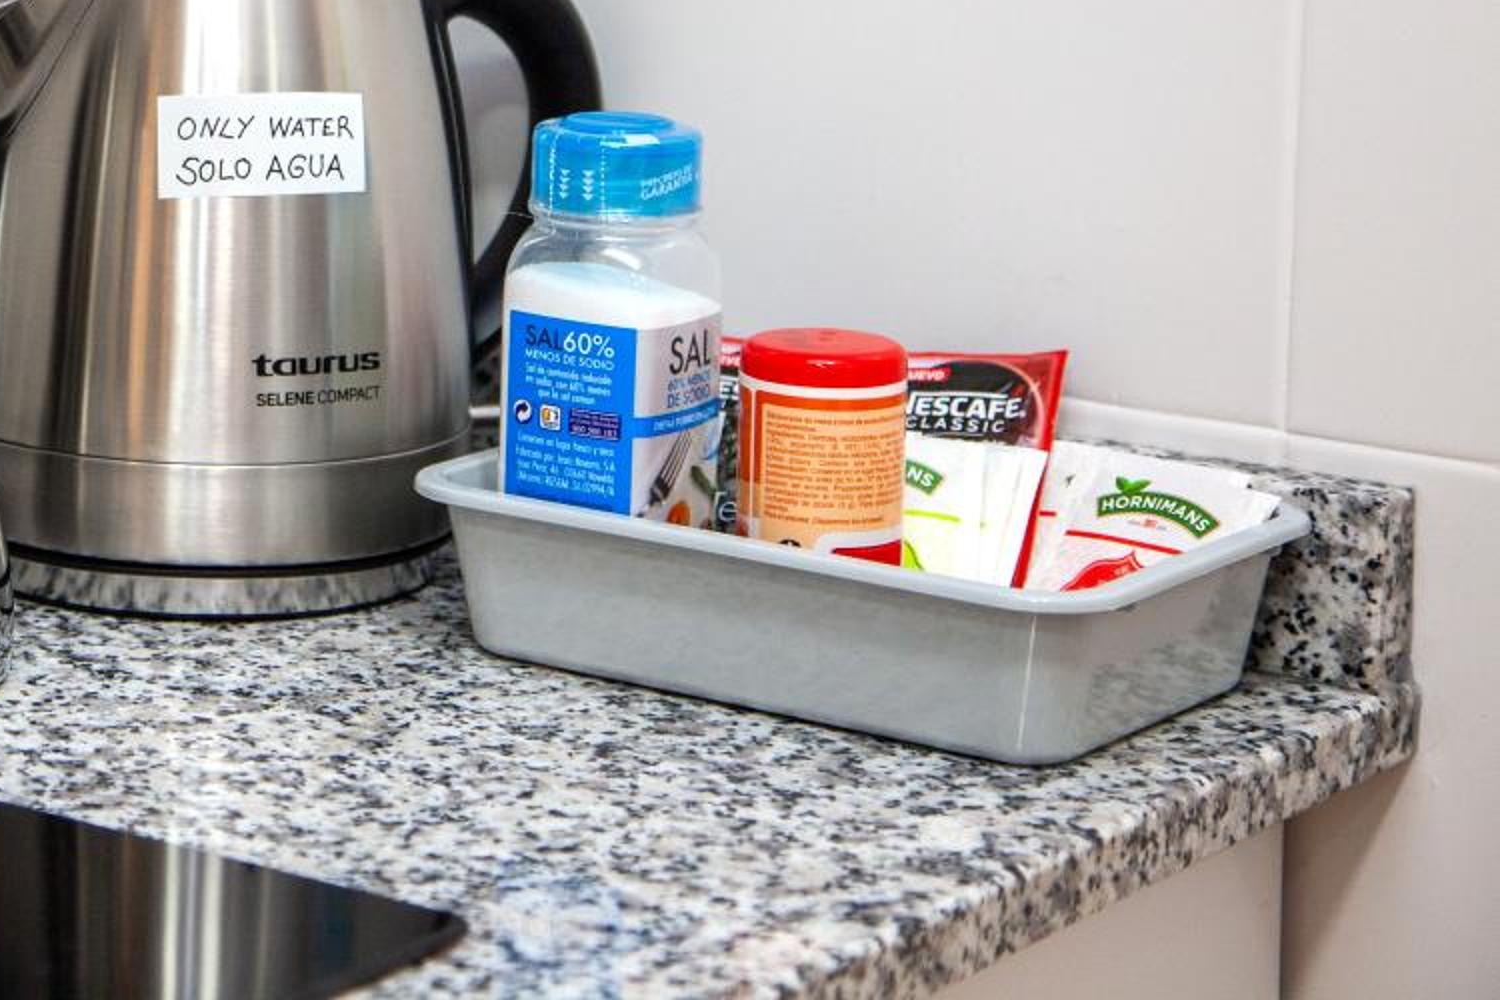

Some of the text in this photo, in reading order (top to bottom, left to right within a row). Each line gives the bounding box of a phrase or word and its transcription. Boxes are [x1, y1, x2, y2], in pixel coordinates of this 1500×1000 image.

[177, 115, 354, 140] ONLY WATER
[176, 154, 345, 186] SOLO AGUA
[252, 351, 381, 377] taurus
[525, 348, 615, 371] MENOS DE SODIO
[669, 329, 711, 375] SAL
[256, 386, 381, 407] SELENE COMPACT
[906, 415, 1005, 433] CLASSIC
[1101, 495, 1211, 532] HORNIMANS
